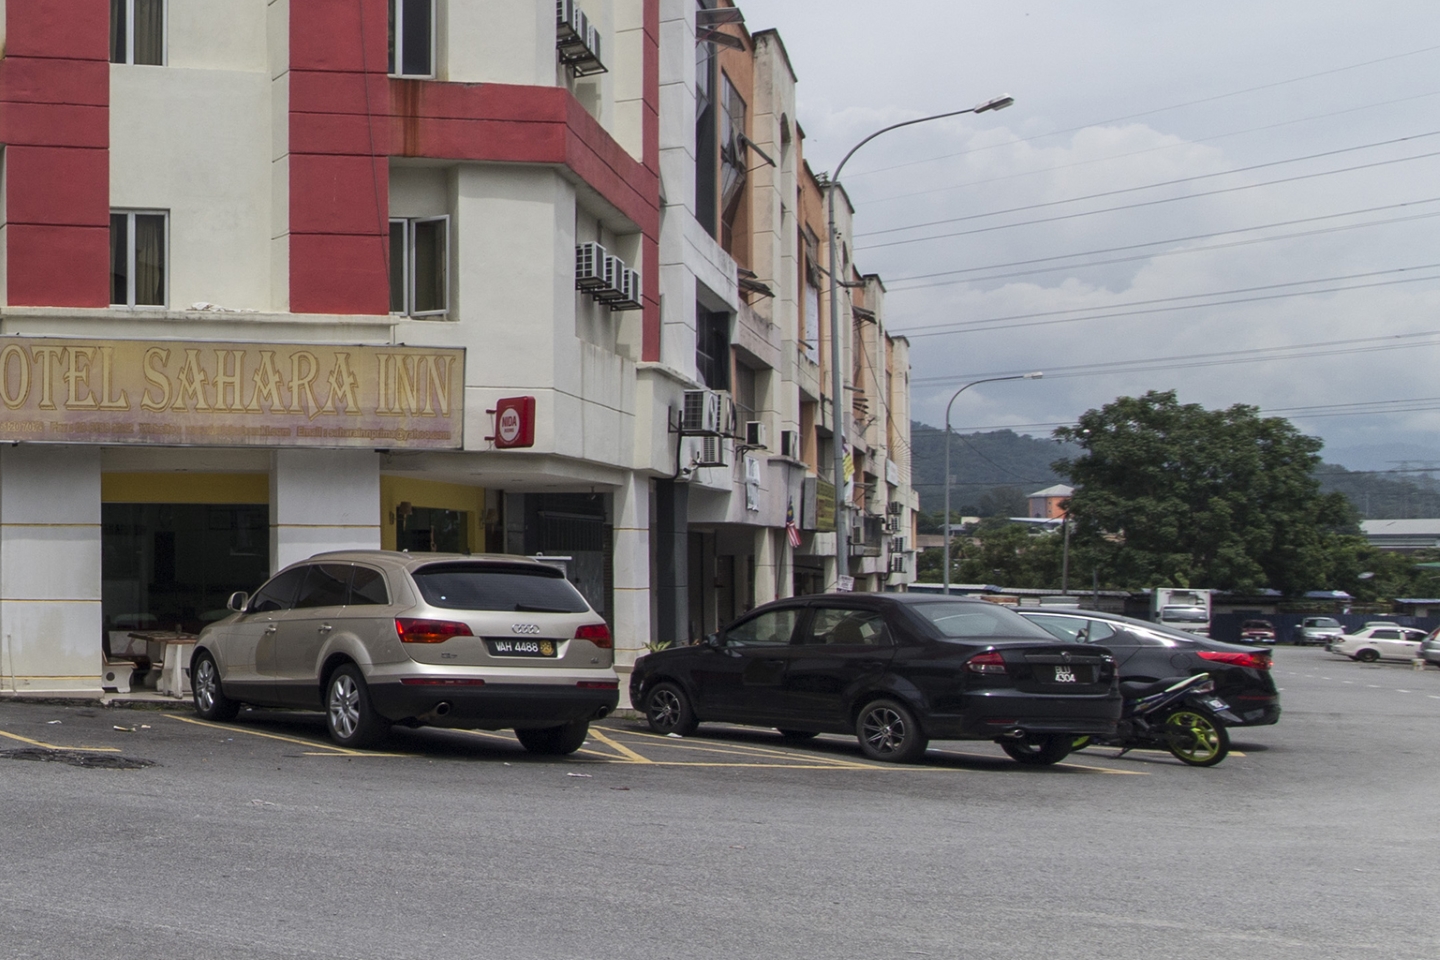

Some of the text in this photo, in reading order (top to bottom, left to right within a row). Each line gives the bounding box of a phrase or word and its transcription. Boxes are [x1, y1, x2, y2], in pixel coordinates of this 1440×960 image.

[141, 346, 362, 421] SAHARA
[376, 352, 456, 417] INN
[502, 415, 517, 428] NIDA
[296, 426, 323, 438] Email
[495, 641, 538, 653] VAH 4488
[1055, 666, 1071, 674] BLU
[1054, 674, 1076, 683] 4304
